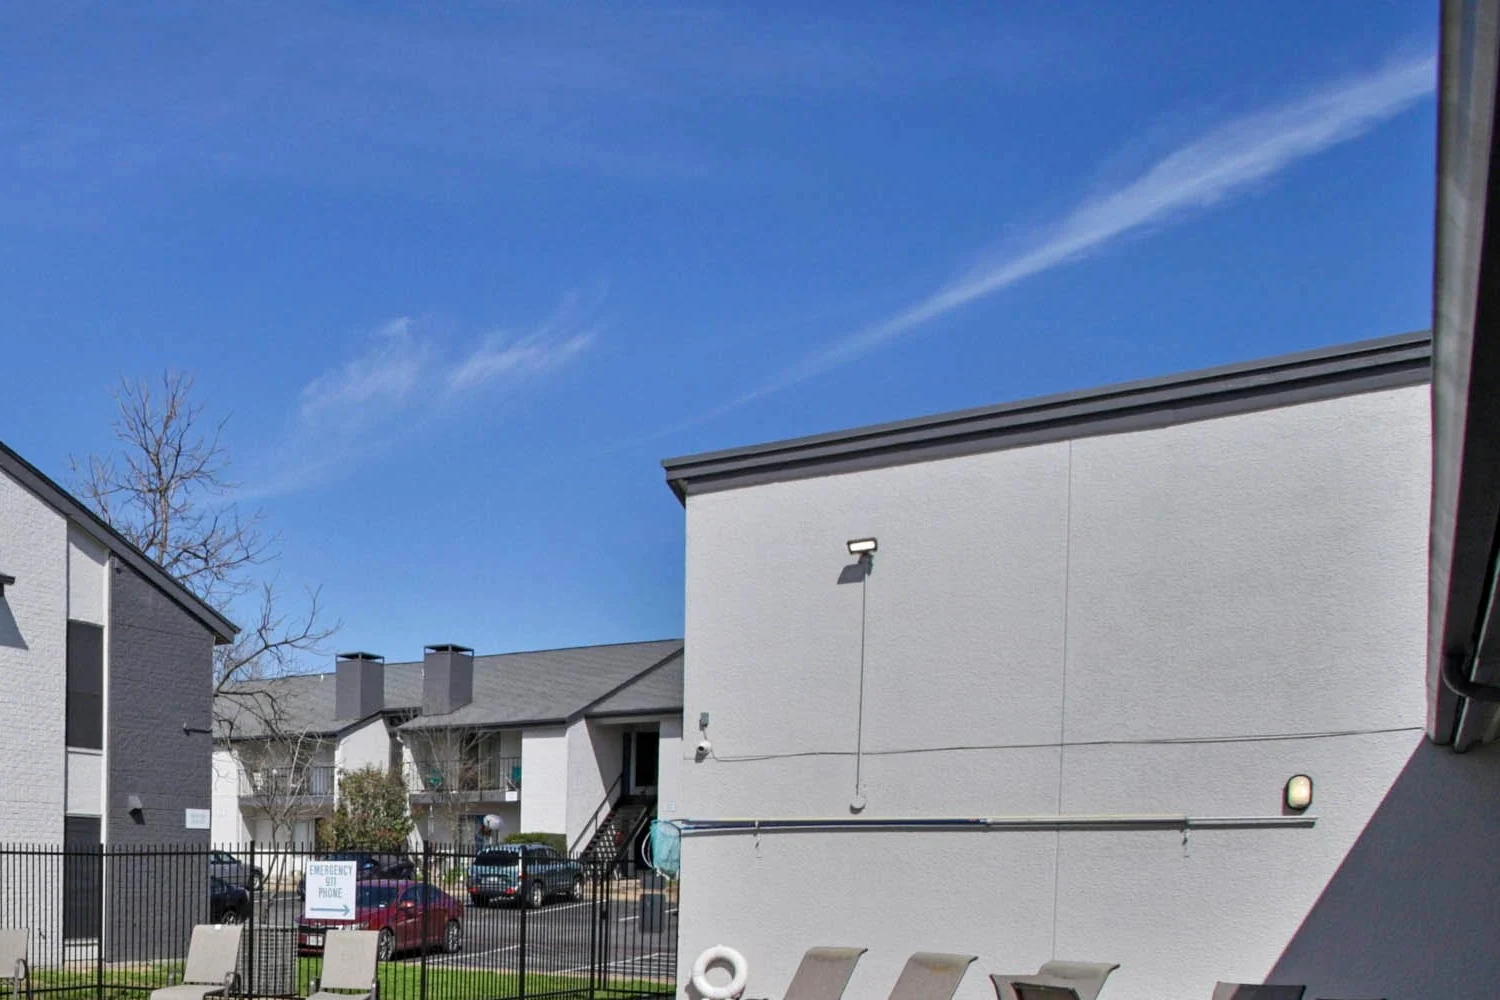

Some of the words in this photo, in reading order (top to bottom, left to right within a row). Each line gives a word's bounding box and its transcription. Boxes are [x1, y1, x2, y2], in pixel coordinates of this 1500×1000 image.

[310, 864, 352, 876] EMERGENCY
[325, 876, 336, 887] 911
[319, 887, 342, 898] PHONE
